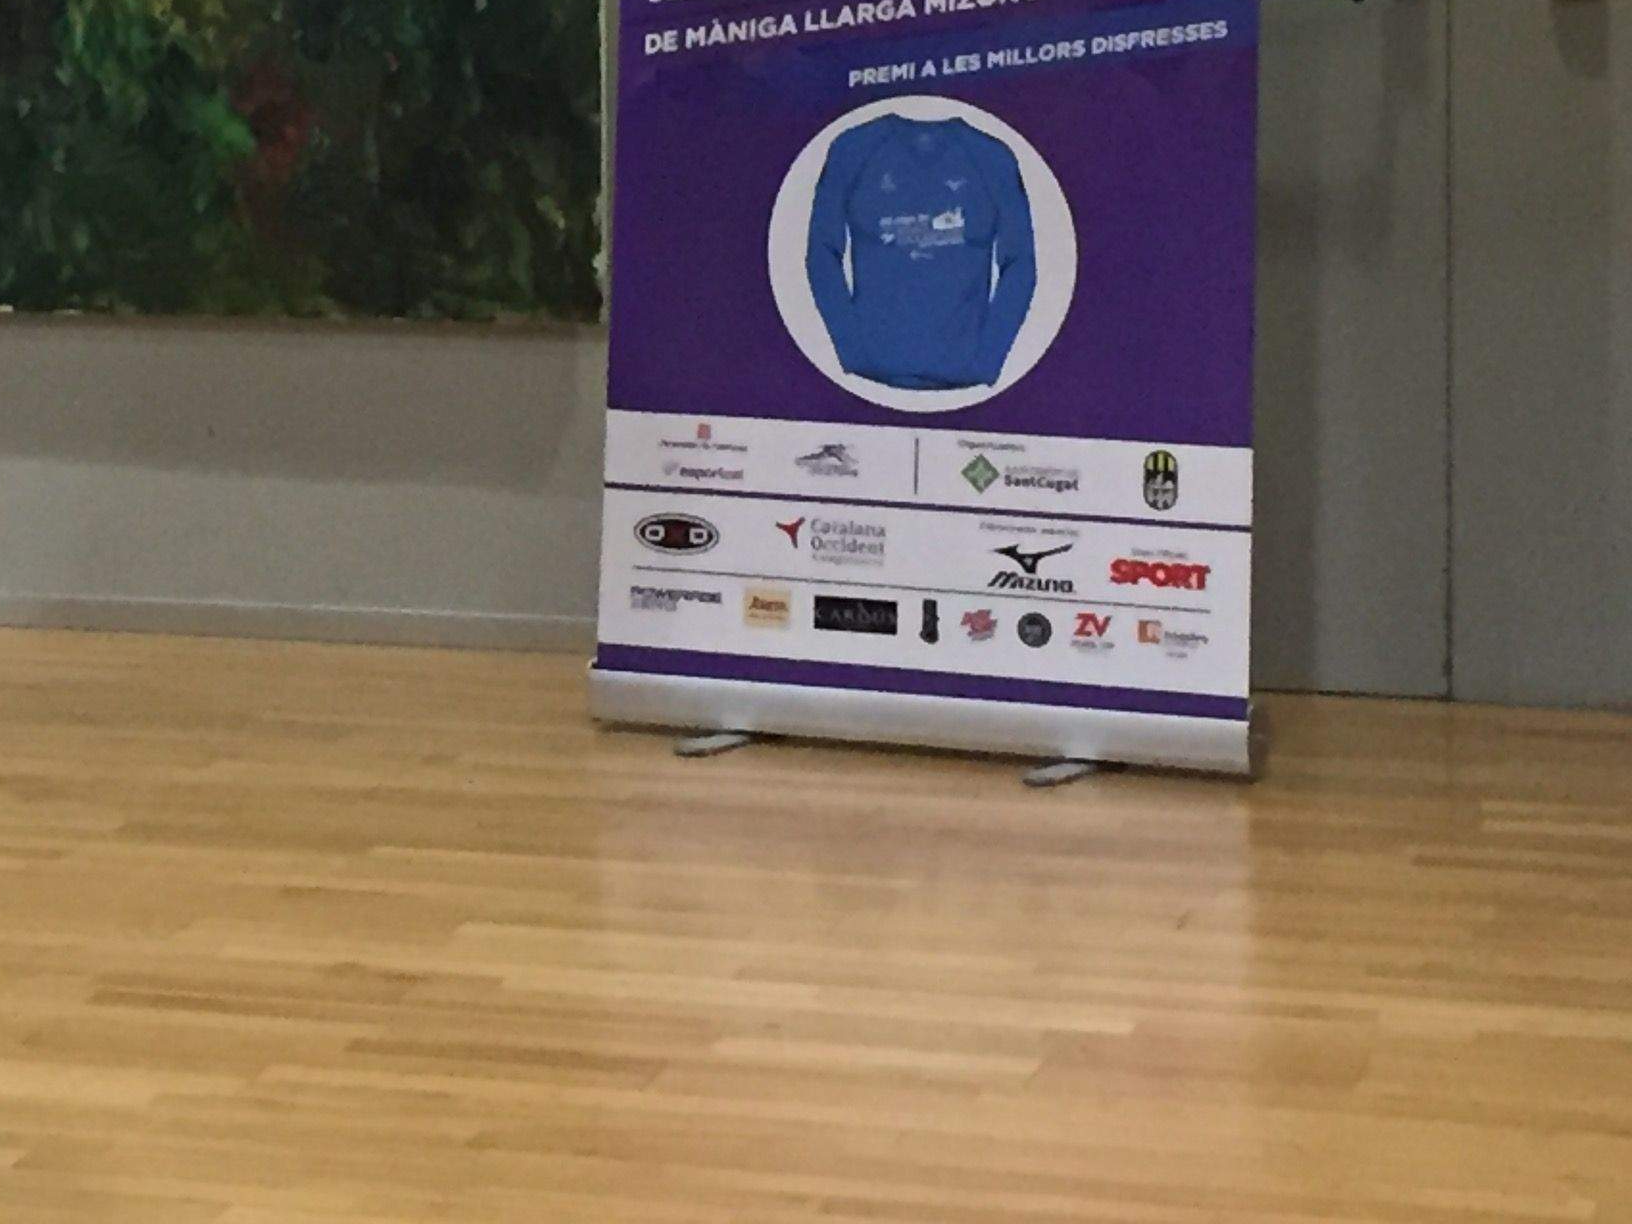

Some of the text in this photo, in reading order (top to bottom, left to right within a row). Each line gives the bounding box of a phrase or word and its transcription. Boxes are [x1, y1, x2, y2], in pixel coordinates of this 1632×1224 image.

[643, 28, 680, 55] DE
[684, 13, 798, 49] MÀNIGA
[847, 20, 1229, 89] PREMI A LES MILLORS DISFRESSES
[810, 518, 886, 538] Catalana
[809, 535, 885, 555] Occident
[1109, 558, 1212, 591] SPORT
